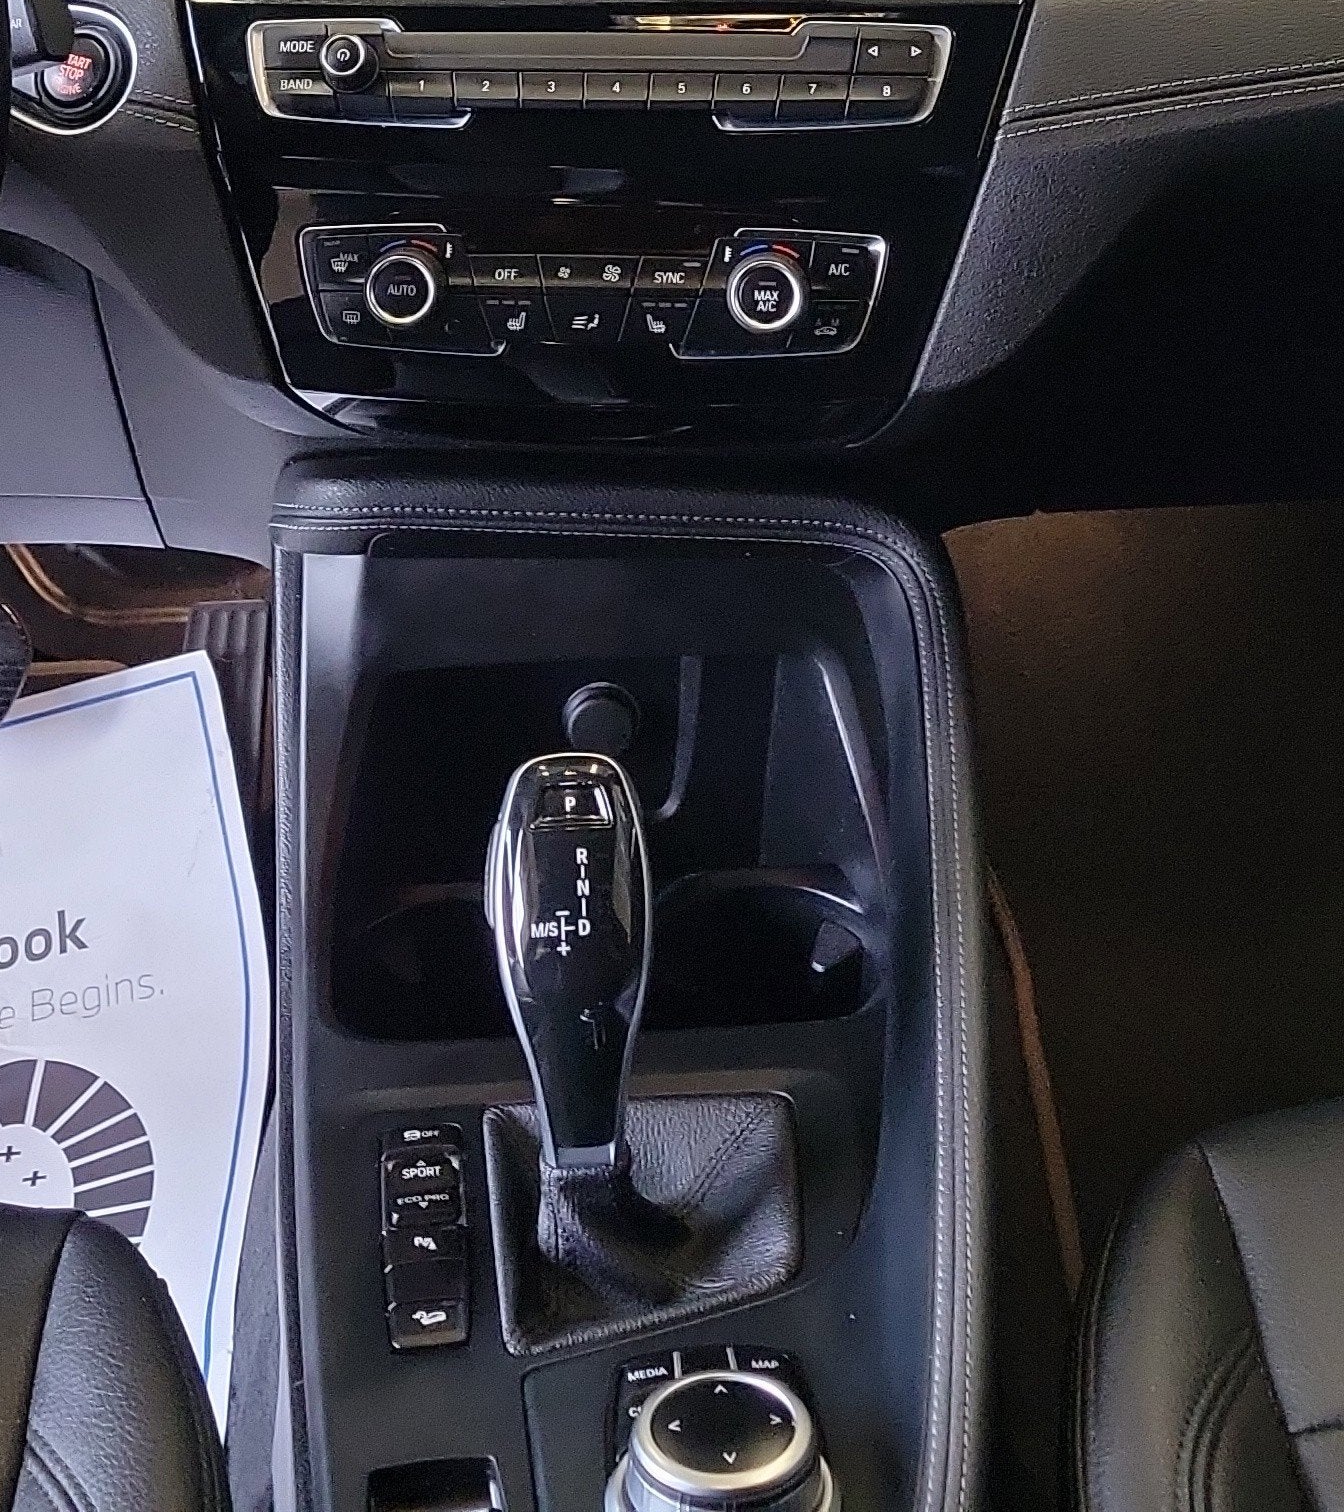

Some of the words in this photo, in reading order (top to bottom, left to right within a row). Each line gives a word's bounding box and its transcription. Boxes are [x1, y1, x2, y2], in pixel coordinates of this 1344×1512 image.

[279, 40, 315, 53] MODE
[66, 53, 92, 69] TART
[59, 64, 84, 80] STOP
[280, 78, 313, 91] BAND
[418, 79, 425, 92] 1
[481, 80, 491, 92] 2
[547, 80, 556, 93] 3
[612, 81, 621, 93] 4
[677, 82, 687, 94] 5
[742, 83, 751, 95] 6
[808, 83, 818, 95] 7
[882, 85, 891, 97] 8
[339, 252, 359, 263] MAX
[494, 268, 519, 281] OFF
[828, 263, 851, 276] A/C
[653, 271, 686, 285] SYNC
[386, 283, 417, 297] AUTO
[753, 289, 780, 302] MAX
[756, 301, 777, 312] A/C
[565, 795, 577, 813] P
[575, 847, 589, 865] R
[576, 879, 590, 897] N
[530, 921, 559, 939] M/S
[577, 918, 592, 937] D
[31, 973, 165, 1023] Begins.
[402, 1165, 442, 1180] SPORT
[396, 1195, 423, 1206] ECO
[424, 1193, 450, 1202] PRO
[751, 1358, 780, 1369] MAP
[627, 1366, 669, 1383] MEDIA
